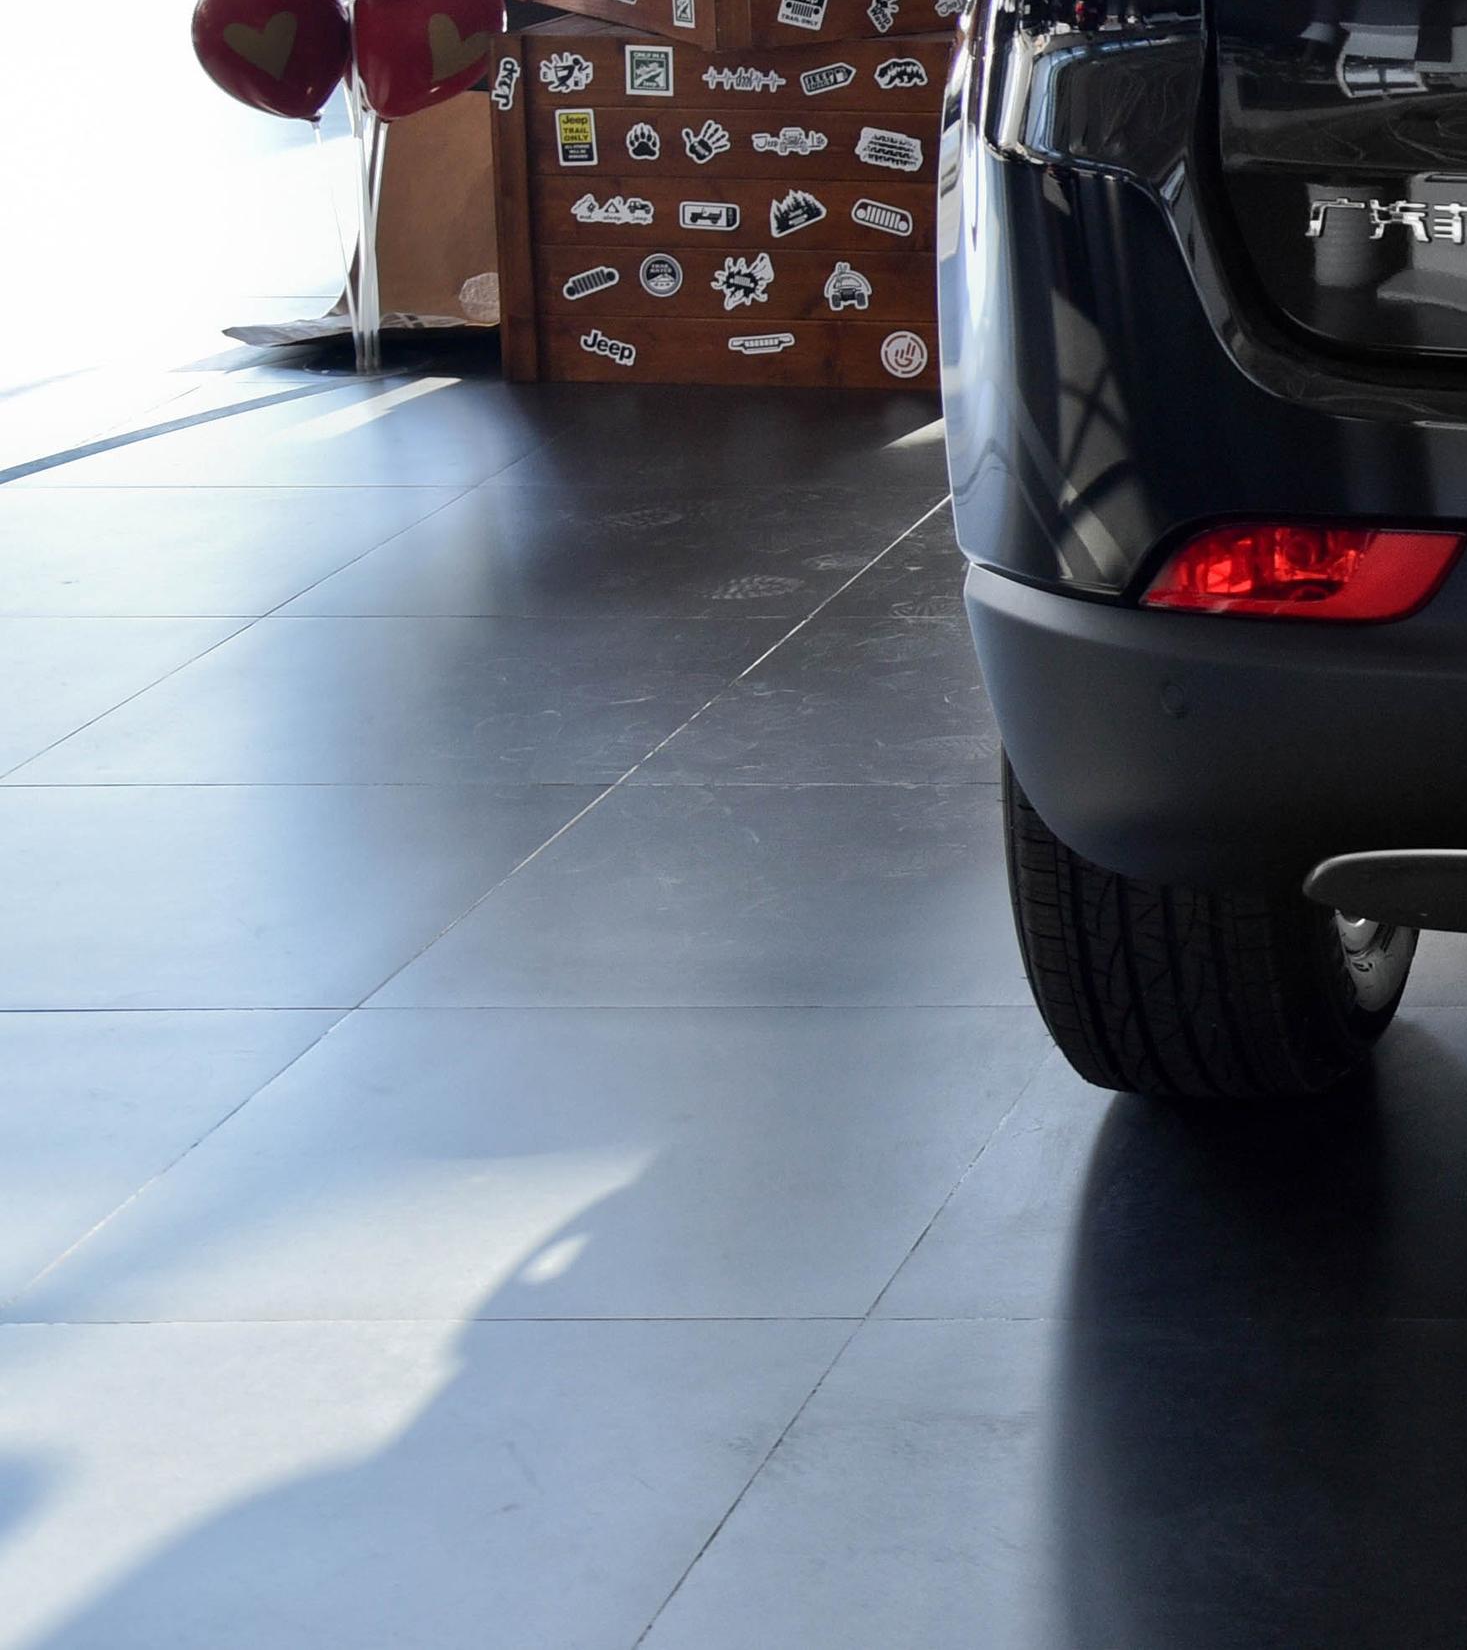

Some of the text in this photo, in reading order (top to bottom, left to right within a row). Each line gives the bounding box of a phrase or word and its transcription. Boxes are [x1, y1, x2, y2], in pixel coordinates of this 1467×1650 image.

[781, 13, 819, 27] TRAIL ONLY
[562, 115, 588, 125] Jeep
[583, 332, 633, 361] Jeep
